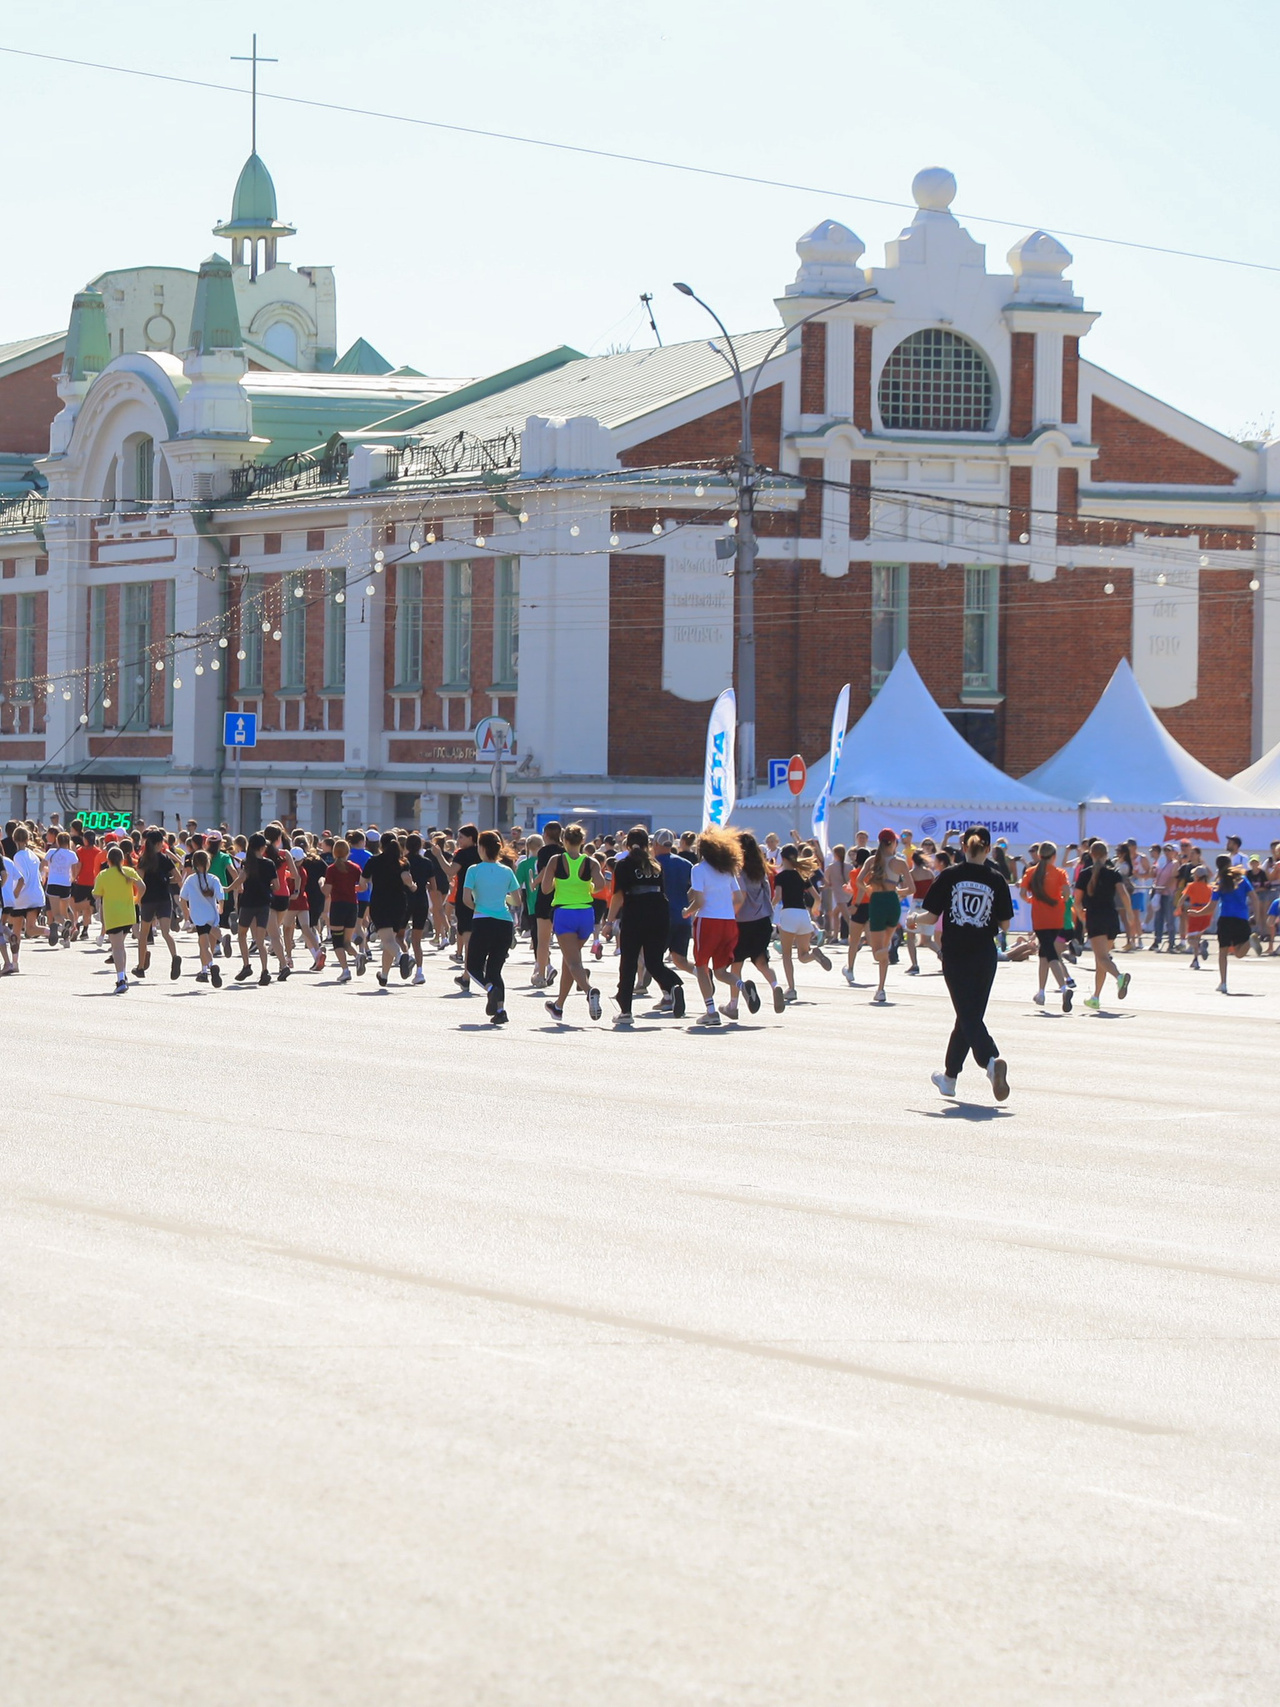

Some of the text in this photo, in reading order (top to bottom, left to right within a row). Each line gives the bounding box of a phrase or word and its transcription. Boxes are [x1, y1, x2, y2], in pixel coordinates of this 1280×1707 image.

[709, 731, 725, 825] МЕТА
[76, 811, 131, 830] 0:00:26
[963, 895, 981, 915] 10
